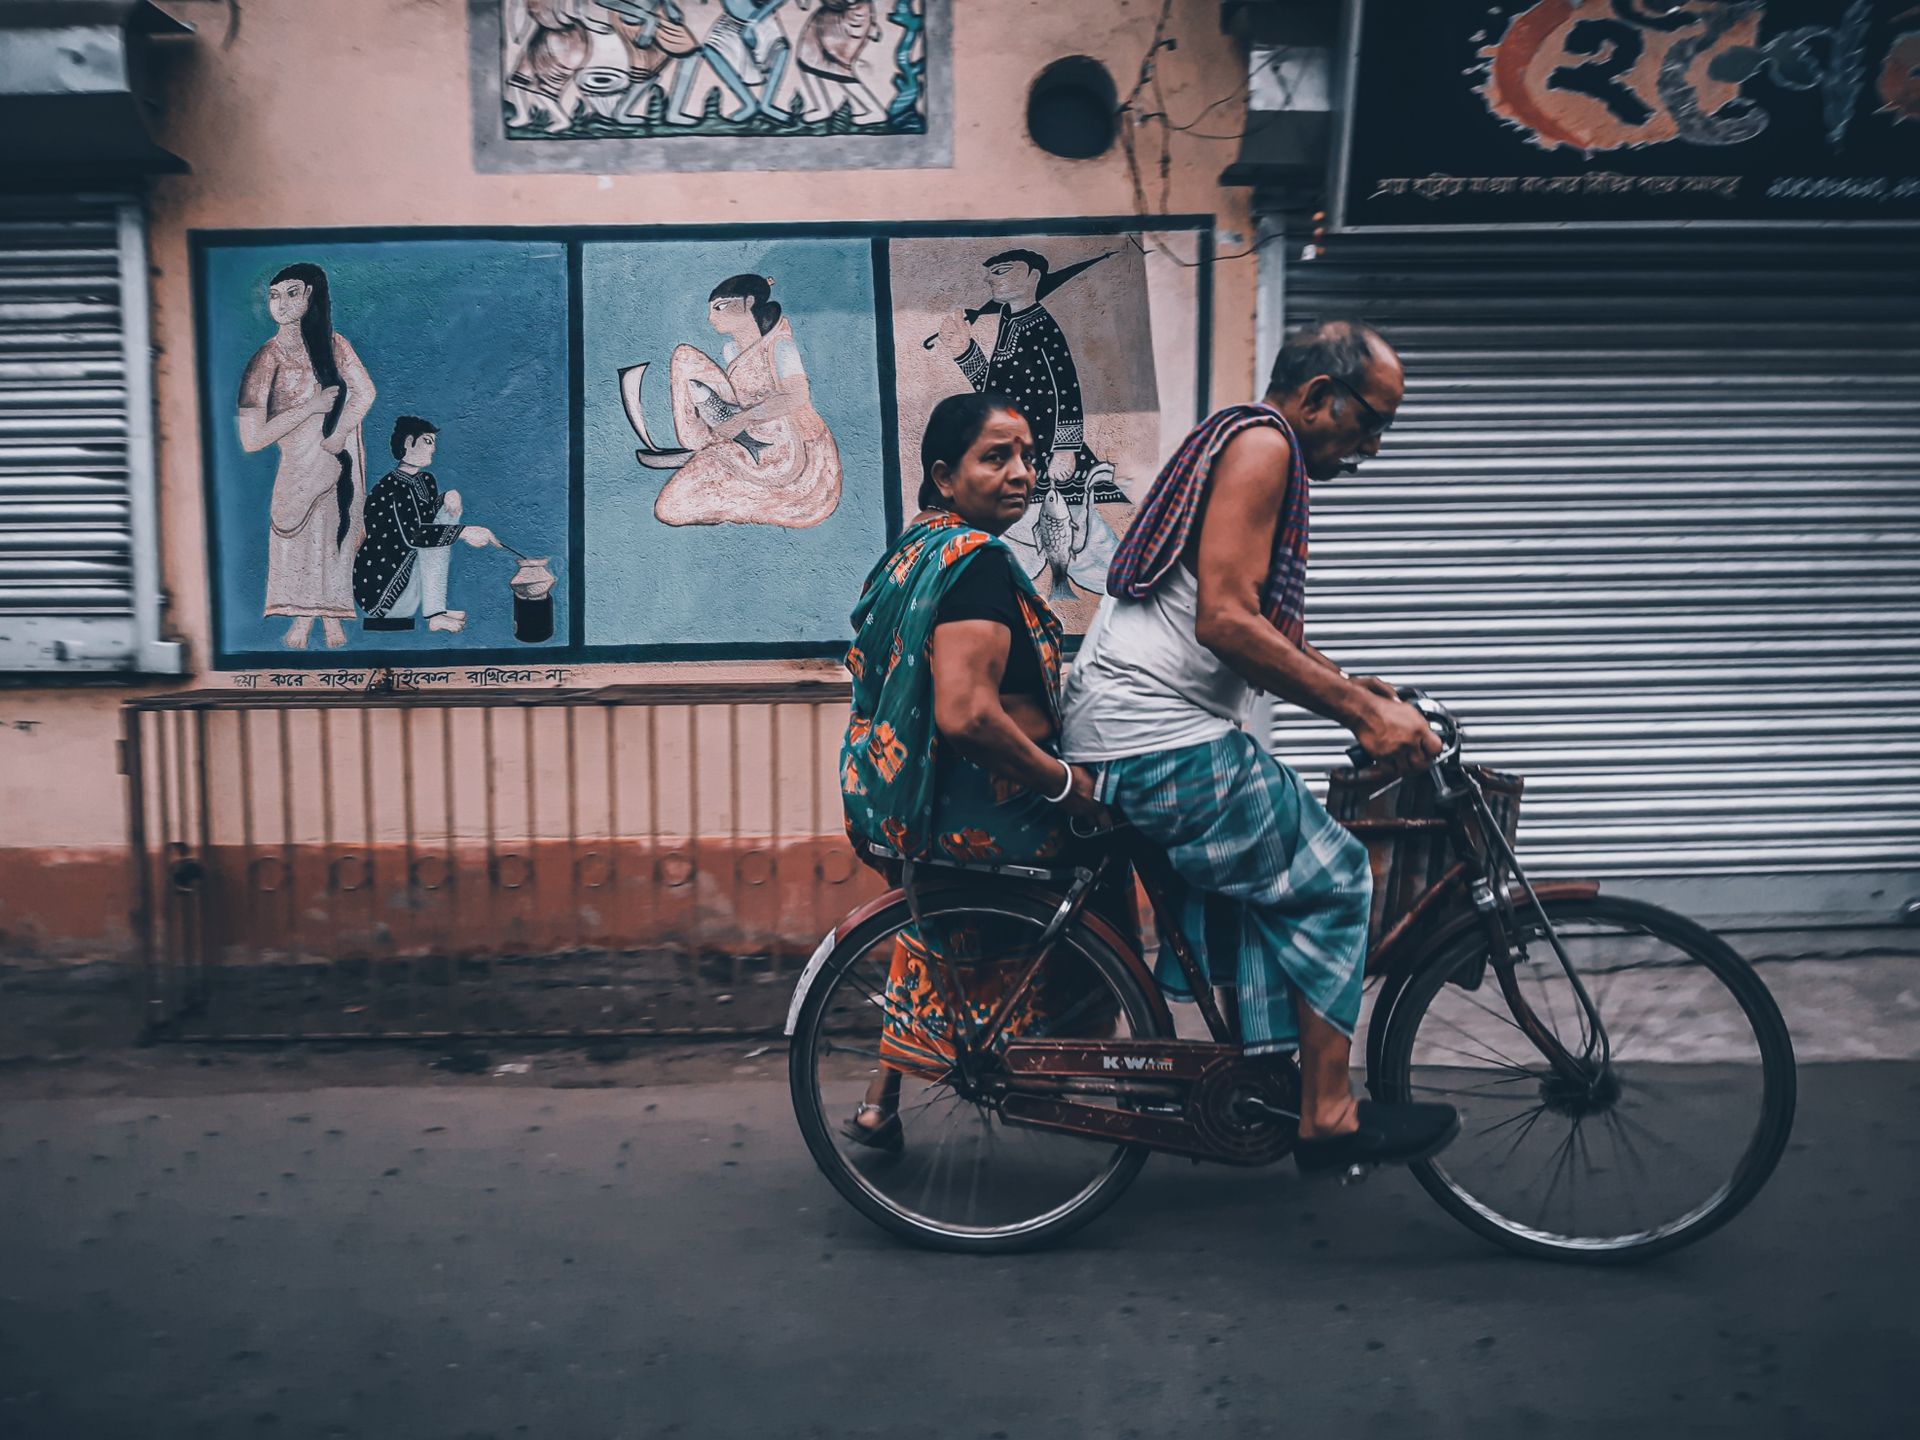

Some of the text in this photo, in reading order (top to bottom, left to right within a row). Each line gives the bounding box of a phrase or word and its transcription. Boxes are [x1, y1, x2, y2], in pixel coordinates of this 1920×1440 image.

[269, 674, 309, 687] করে
[465, 667, 541, 686] রাখিবেন
[545, 669, 571, 683] না
